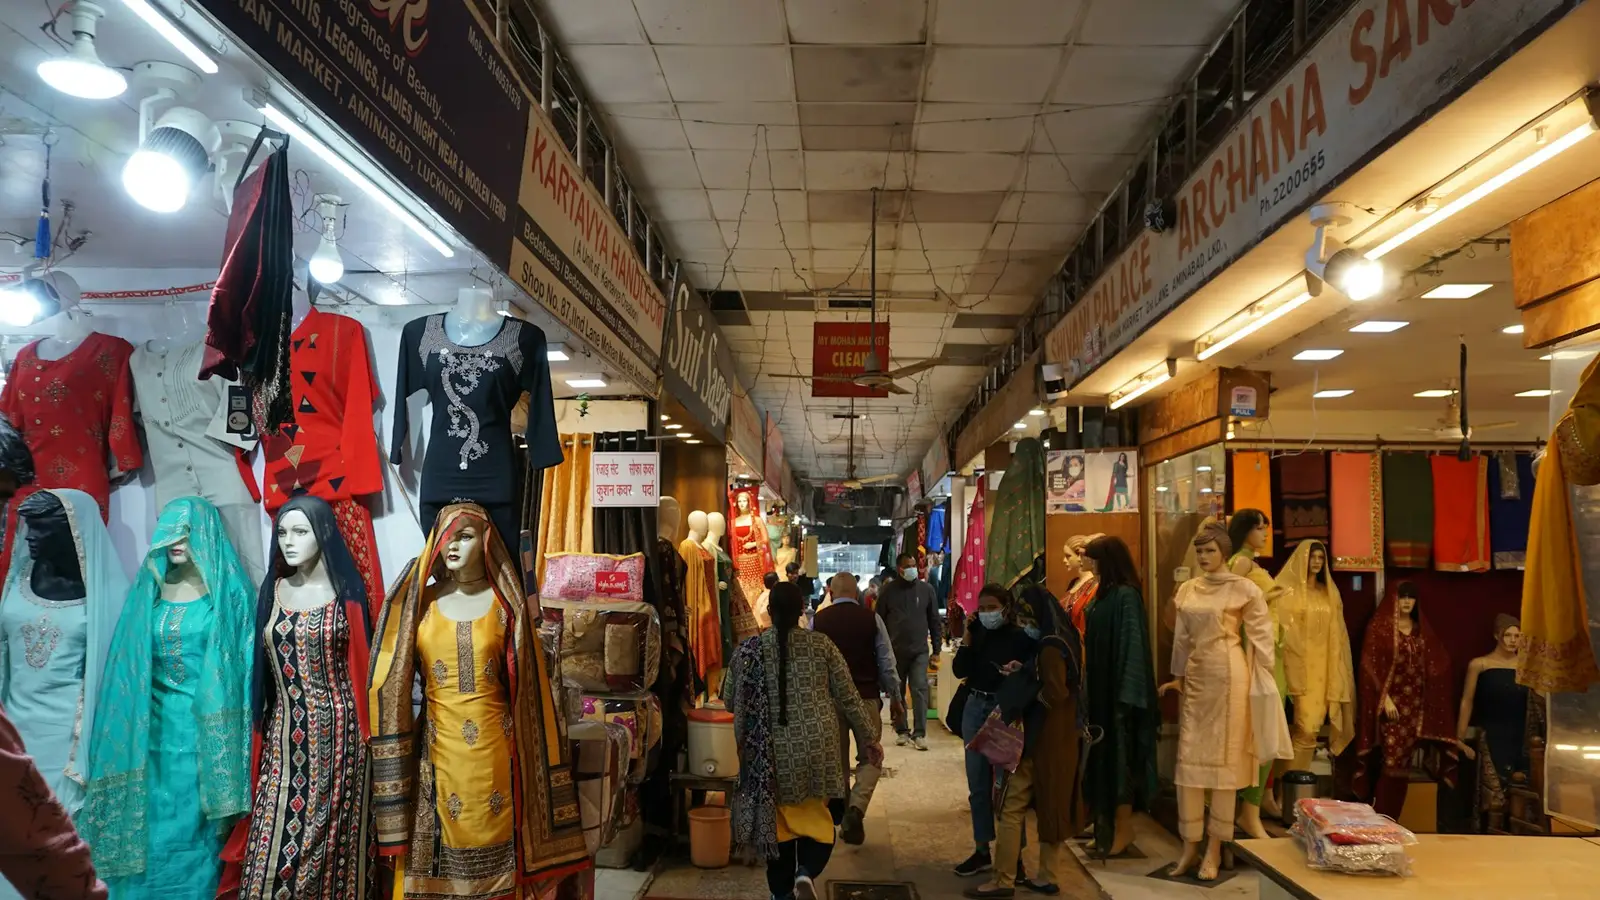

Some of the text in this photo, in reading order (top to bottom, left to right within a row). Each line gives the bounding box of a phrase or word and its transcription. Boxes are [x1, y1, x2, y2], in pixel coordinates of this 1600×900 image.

[392, 54, 406, 76] of
[277, 22, 343, 104] MARKET,
[347, 93, 414, 171] AMINABAD,
[417, 159, 463, 213] LUCKNOW
[325, 16, 380, 96] LEGGINGS,
[381, 76, 413, 125] LADIES
[413, 110, 438, 151] NIGHT
[438, 136, 459, 173] WEAR
[457, 160, 464, 178] &
[465, 165, 491, 205] WOOLEN
[489, 194, 507, 222] ITEMS
[532, 126, 663, 331] KARTAVYA HANDLOOM
[1093, 235, 1152, 328] PALACE
[1179, 62, 1327, 261] ARCHANA
[521, 261, 545, 301] Shop
[546, 282, 558, 312] No.
[585, 319, 600, 347] Lane
[524, 221, 560, 272] Bedsheets
[564, 264, 593, 305] Bedcovers
[1154, 283, 1169, 307] LANE
[668, 282, 732, 427] Suit Sagar
[830, 335, 856, 346] MOHAN
[832, 351, 871, 368] CLEAN
[596, 480, 655, 502] कुशन कवर पर्दा
[643, 463, 655, 476] कवर
